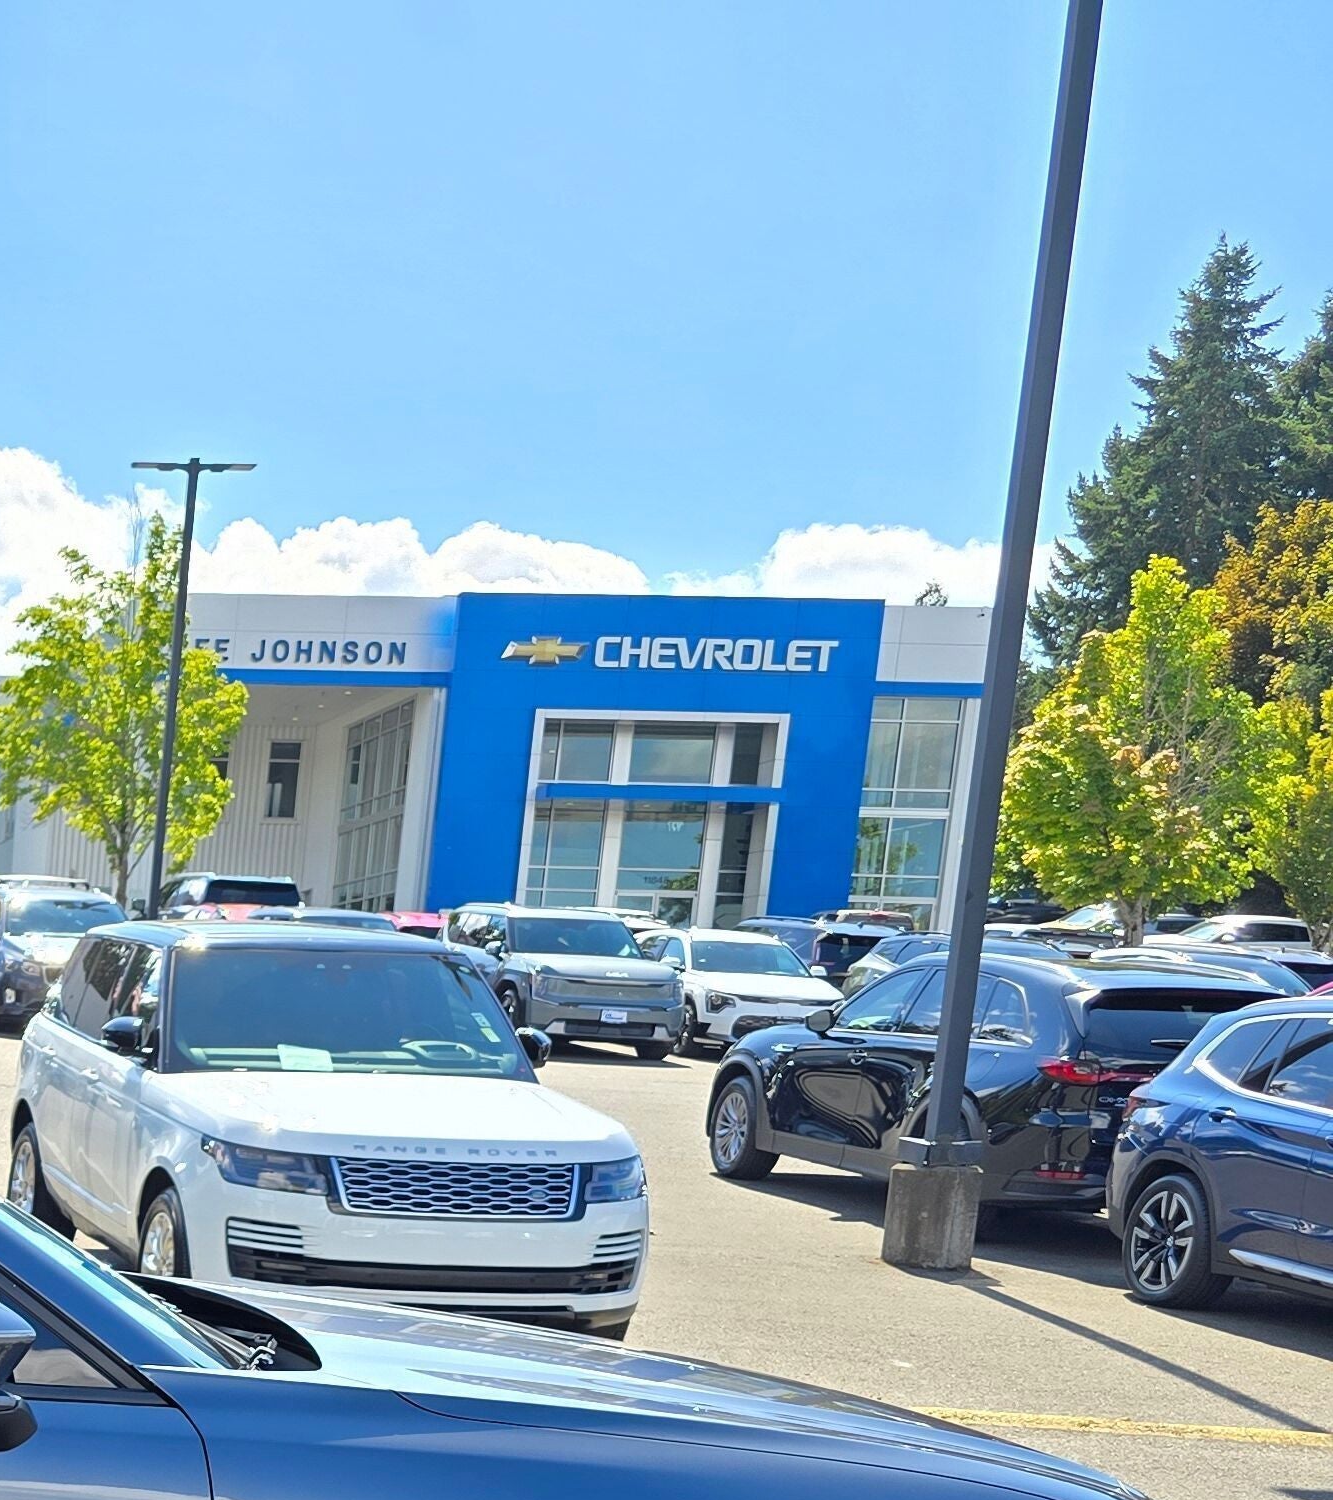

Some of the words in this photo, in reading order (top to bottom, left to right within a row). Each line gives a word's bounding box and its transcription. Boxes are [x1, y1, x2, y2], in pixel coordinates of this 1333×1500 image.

[251, 638, 408, 665] JOHNSON
[594, 636, 840, 673] CHEVROLET
[353, 1144, 446, 1154] RANGE
[467, 1148, 558, 1157] ROVER
